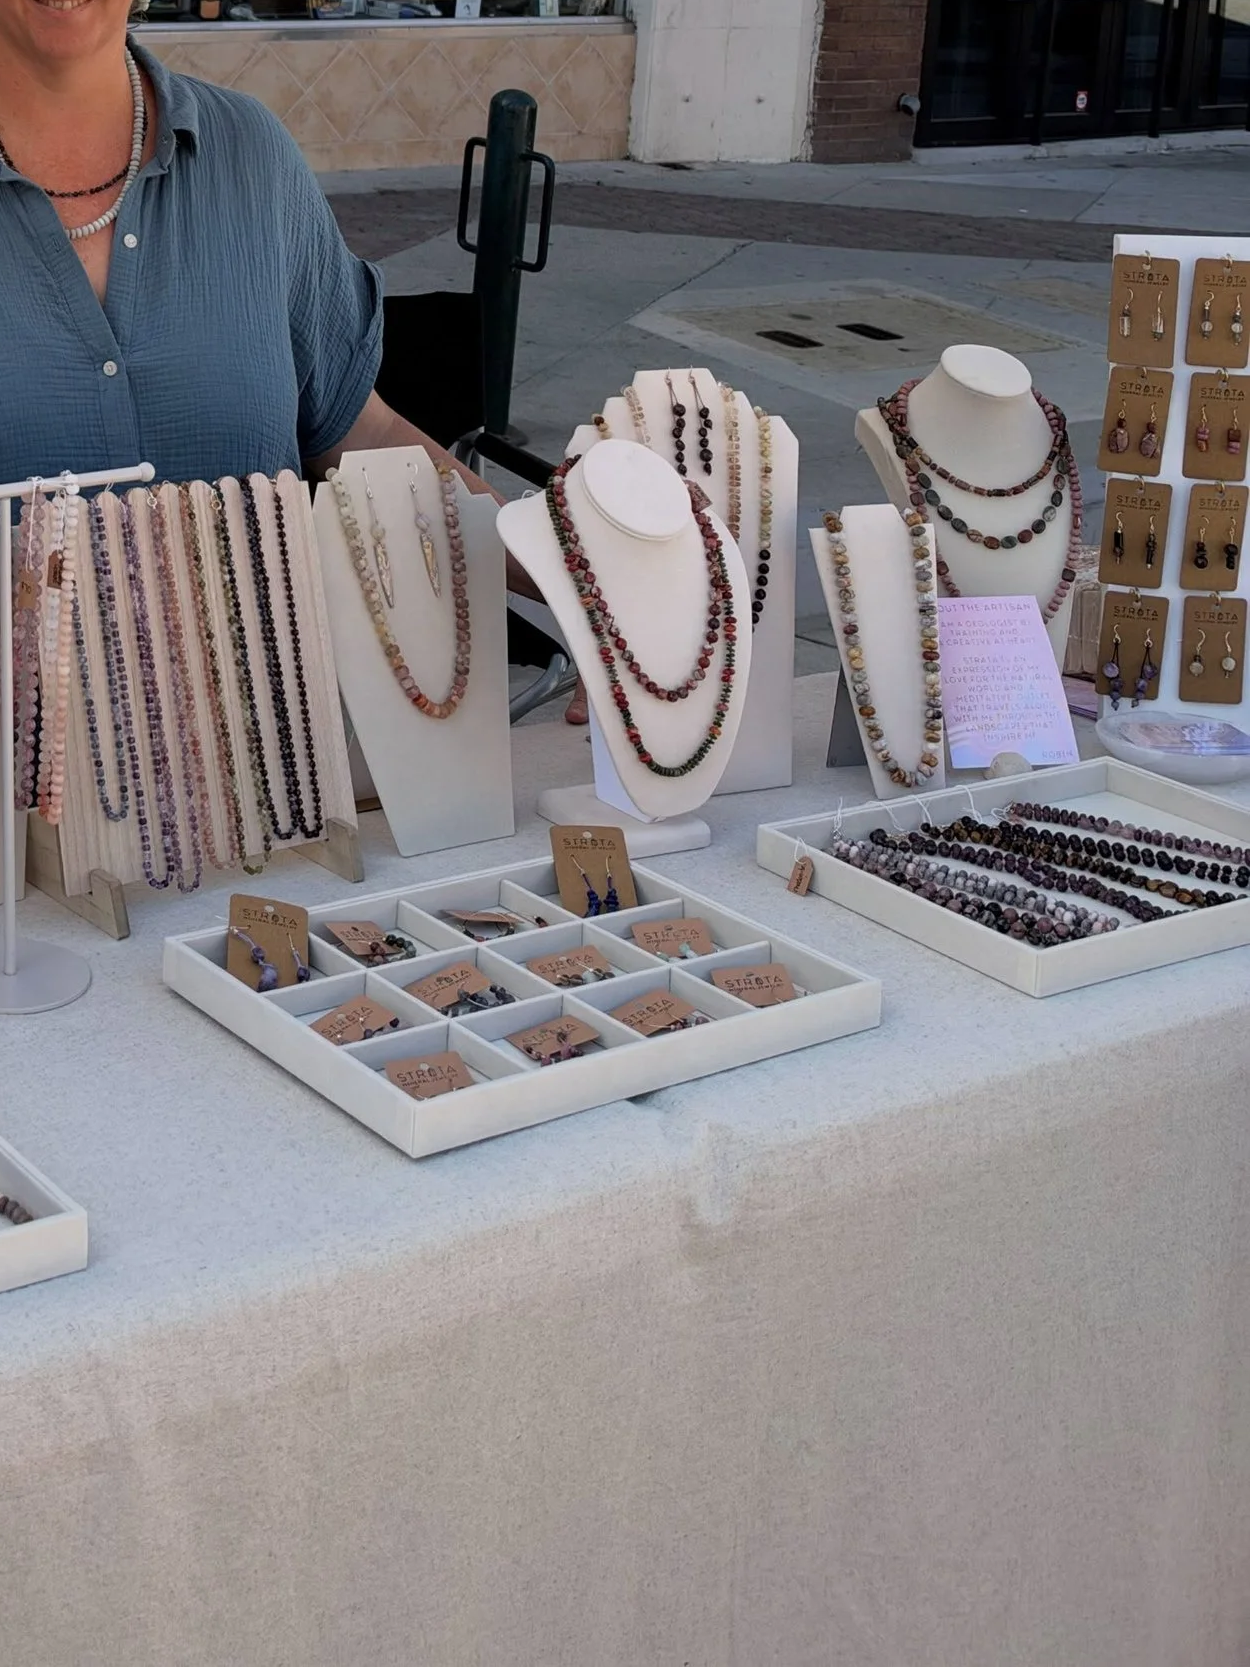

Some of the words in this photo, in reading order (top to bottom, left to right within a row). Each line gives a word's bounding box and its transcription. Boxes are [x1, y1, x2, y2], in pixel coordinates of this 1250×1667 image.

[937, 604, 957, 613] OUT
[960, 603, 981, 612] THE
[984, 602, 1030, 612] ARTISAN
[943, 674, 967, 684] LOVE
[954, 704, 977, 712] THAT
